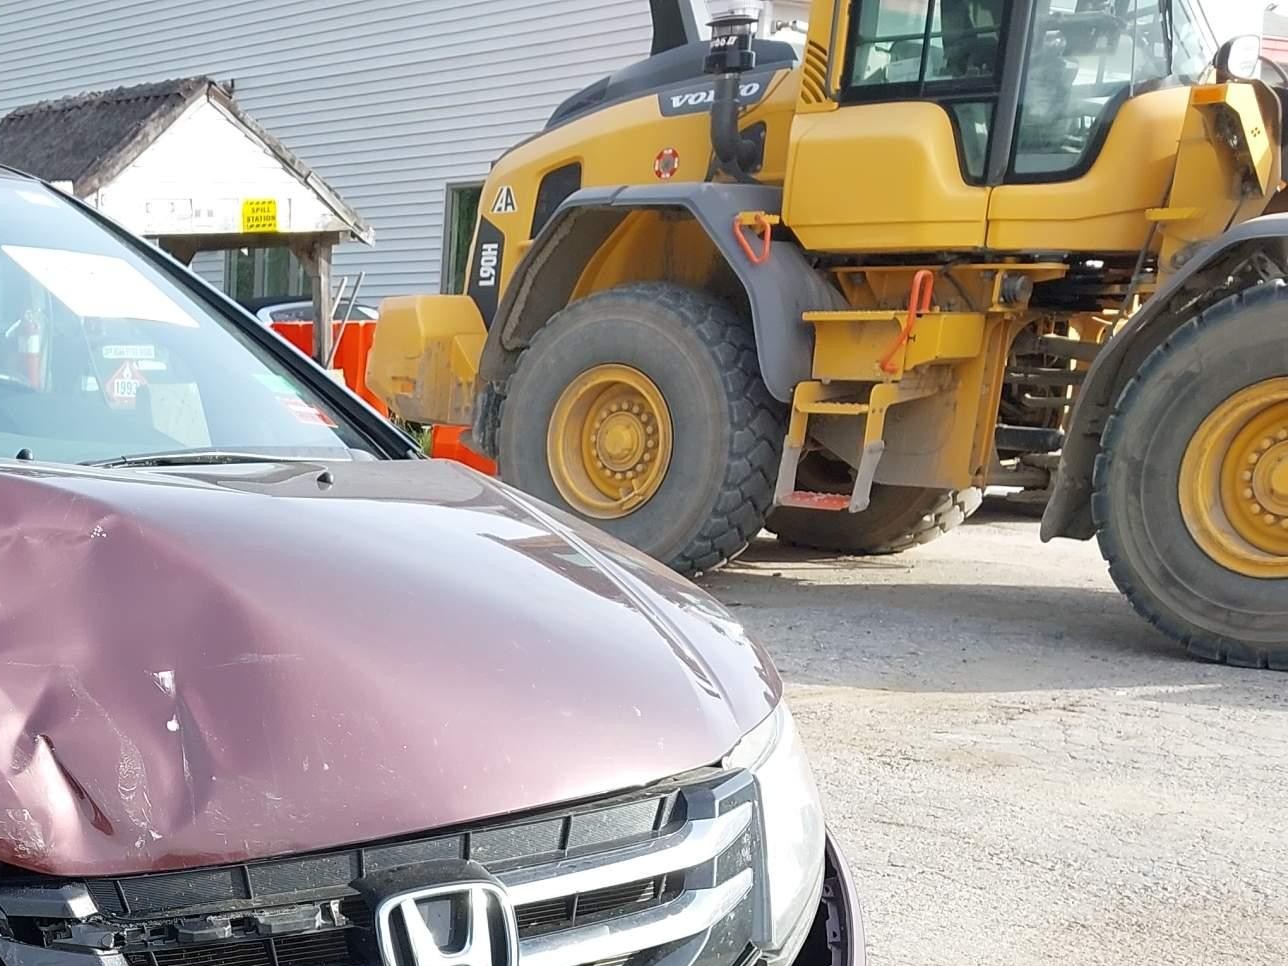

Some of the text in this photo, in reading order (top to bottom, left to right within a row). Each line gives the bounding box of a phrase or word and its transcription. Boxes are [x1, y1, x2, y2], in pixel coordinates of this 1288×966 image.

[670, 83, 760, 108] VOLO
[246, 214, 276, 223] STATION
[251, 206, 270, 214] SPILL
[478, 243, 499, 287] L90H
